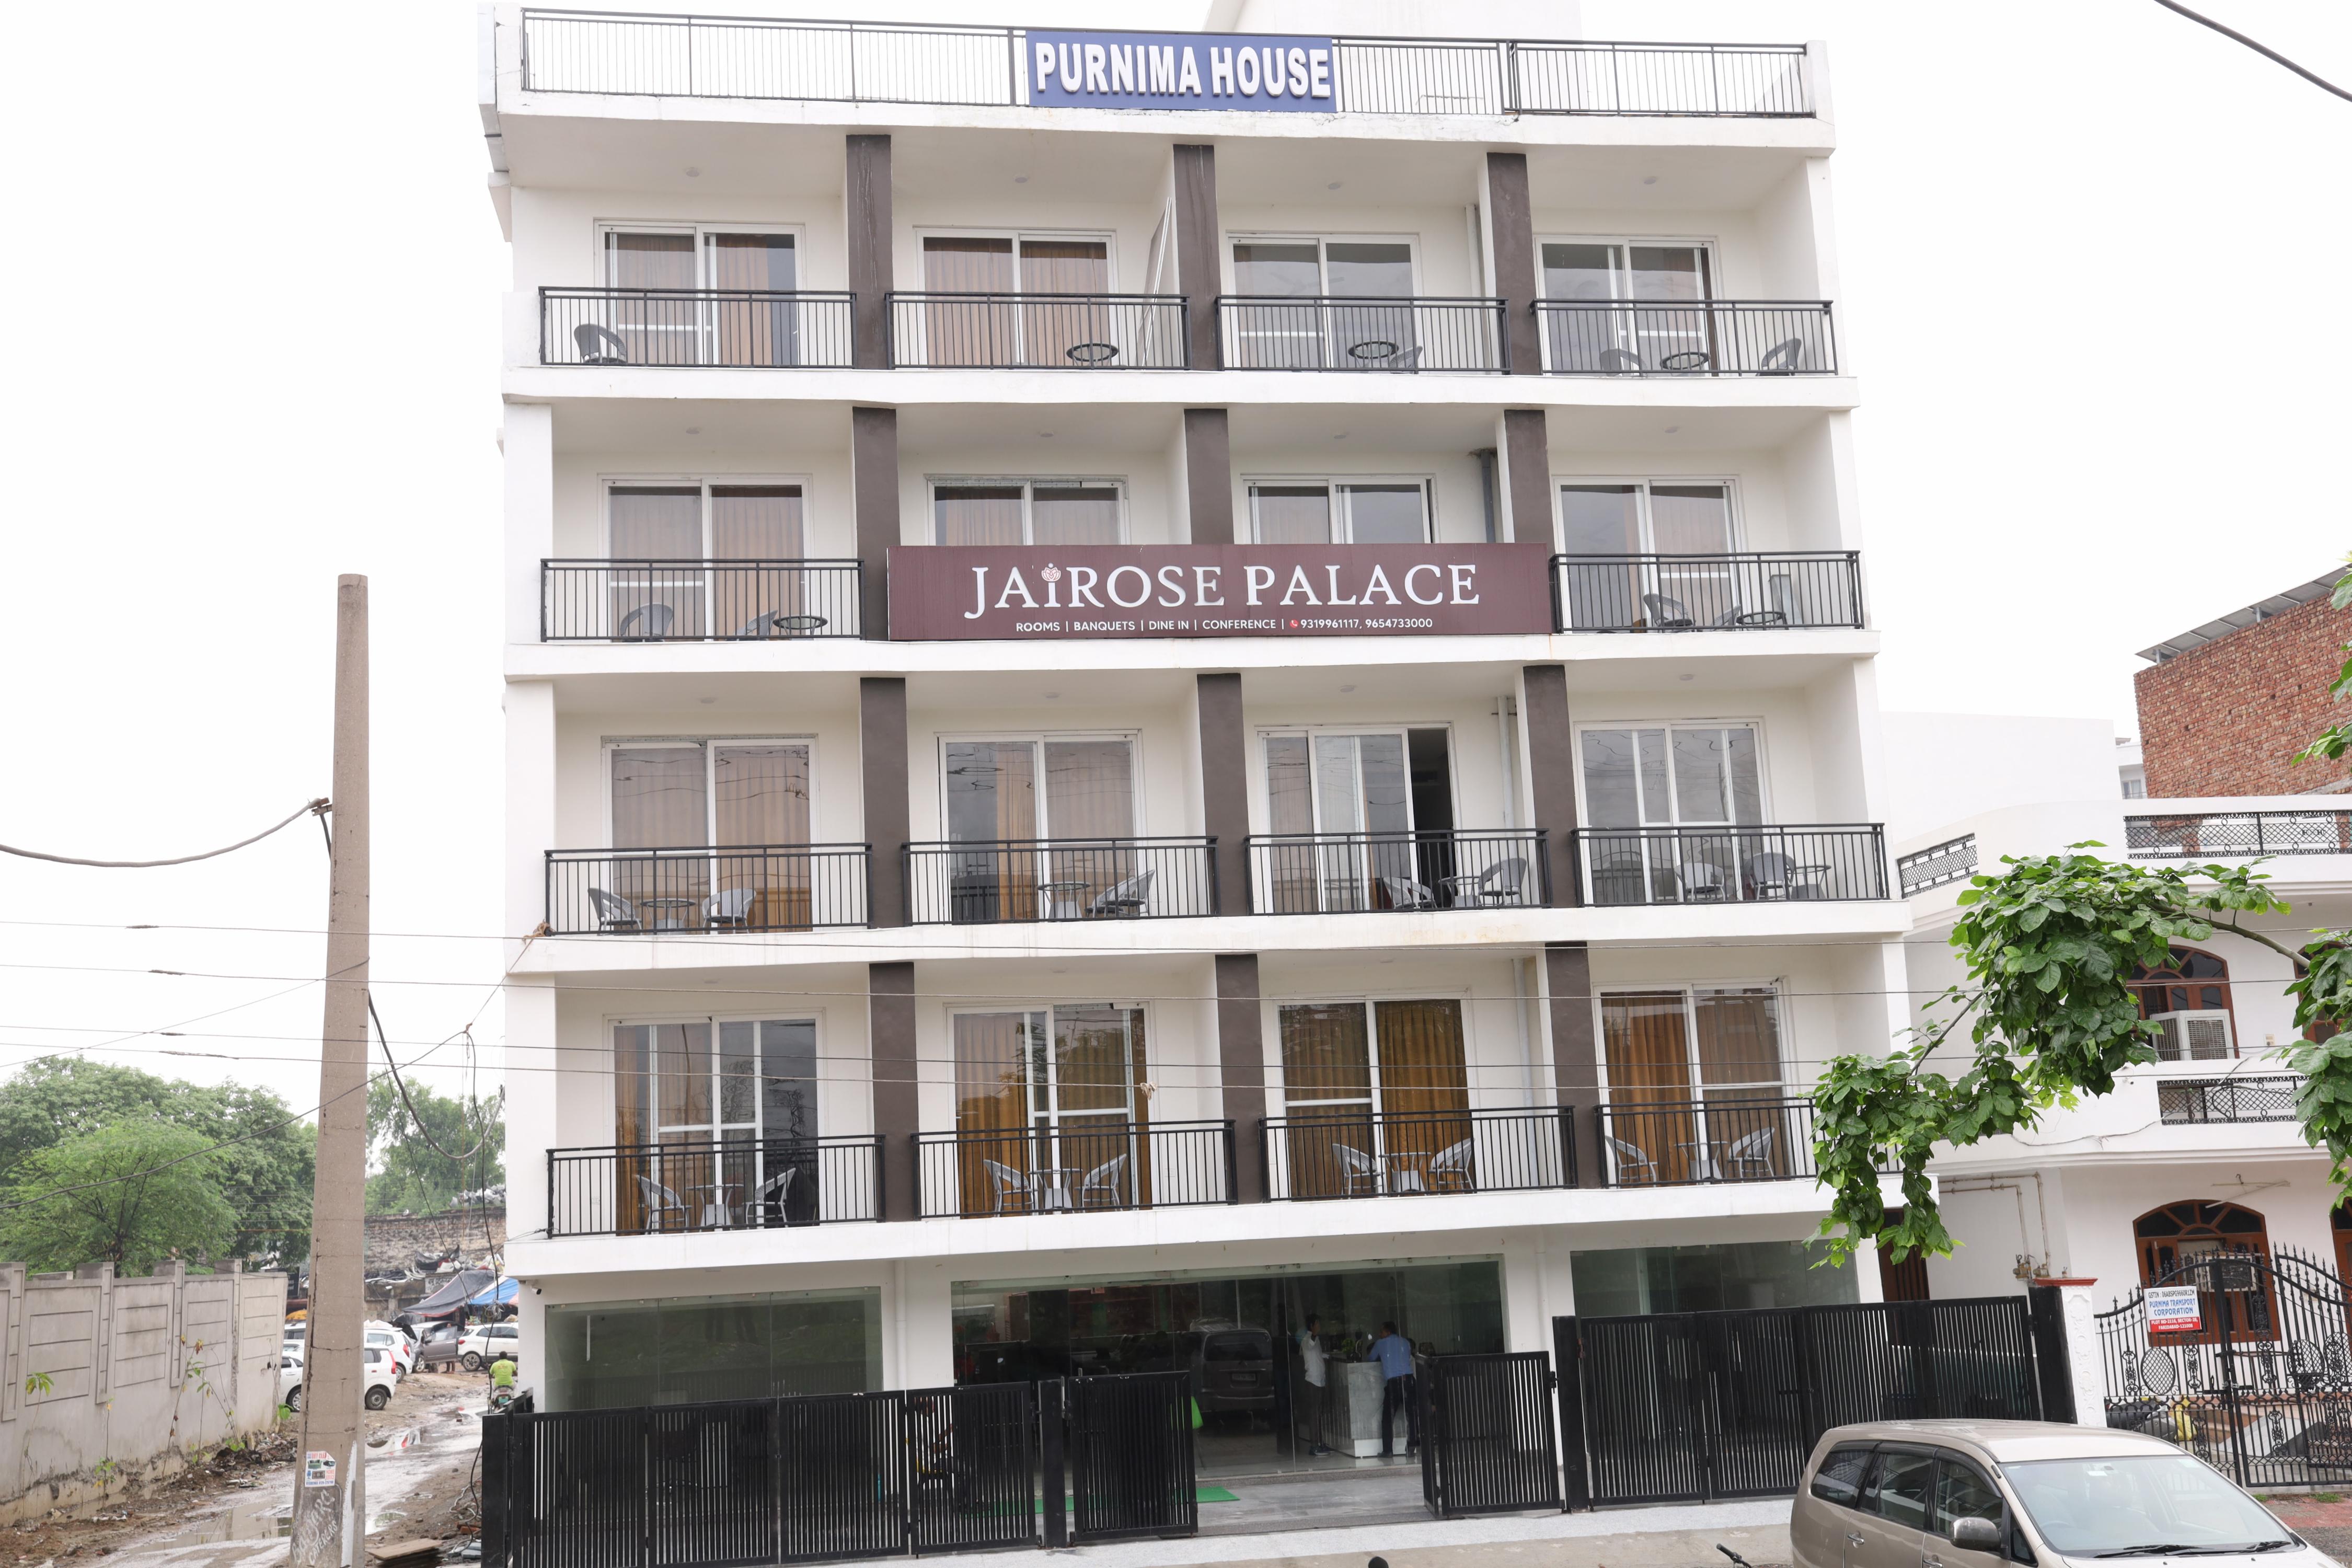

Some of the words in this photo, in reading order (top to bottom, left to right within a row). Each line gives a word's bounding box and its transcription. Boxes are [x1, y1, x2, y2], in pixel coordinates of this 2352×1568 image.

[1035, 42, 1202, 95] PURNIMA
[1210, 46, 1331, 98] HOUSE
[1243, 563, 1480, 606] PALACE
[1016, 621, 1060, 631] ROOMS
[1074, 621, 1135, 631] BANQUETS
[1149, 620, 1174, 630] DINE
[1178, 620, 1189, 630] IN
[1202, 619, 1276, 629] CONFERENCE
[1300, 618, 1362, 630] 9319961117,
[1365, 618, 1433, 628] 9654733000
[2170, 1298, 2195, 1307] TRANSPORT
[2154, 1307, 2193, 1316] CORPORATION
